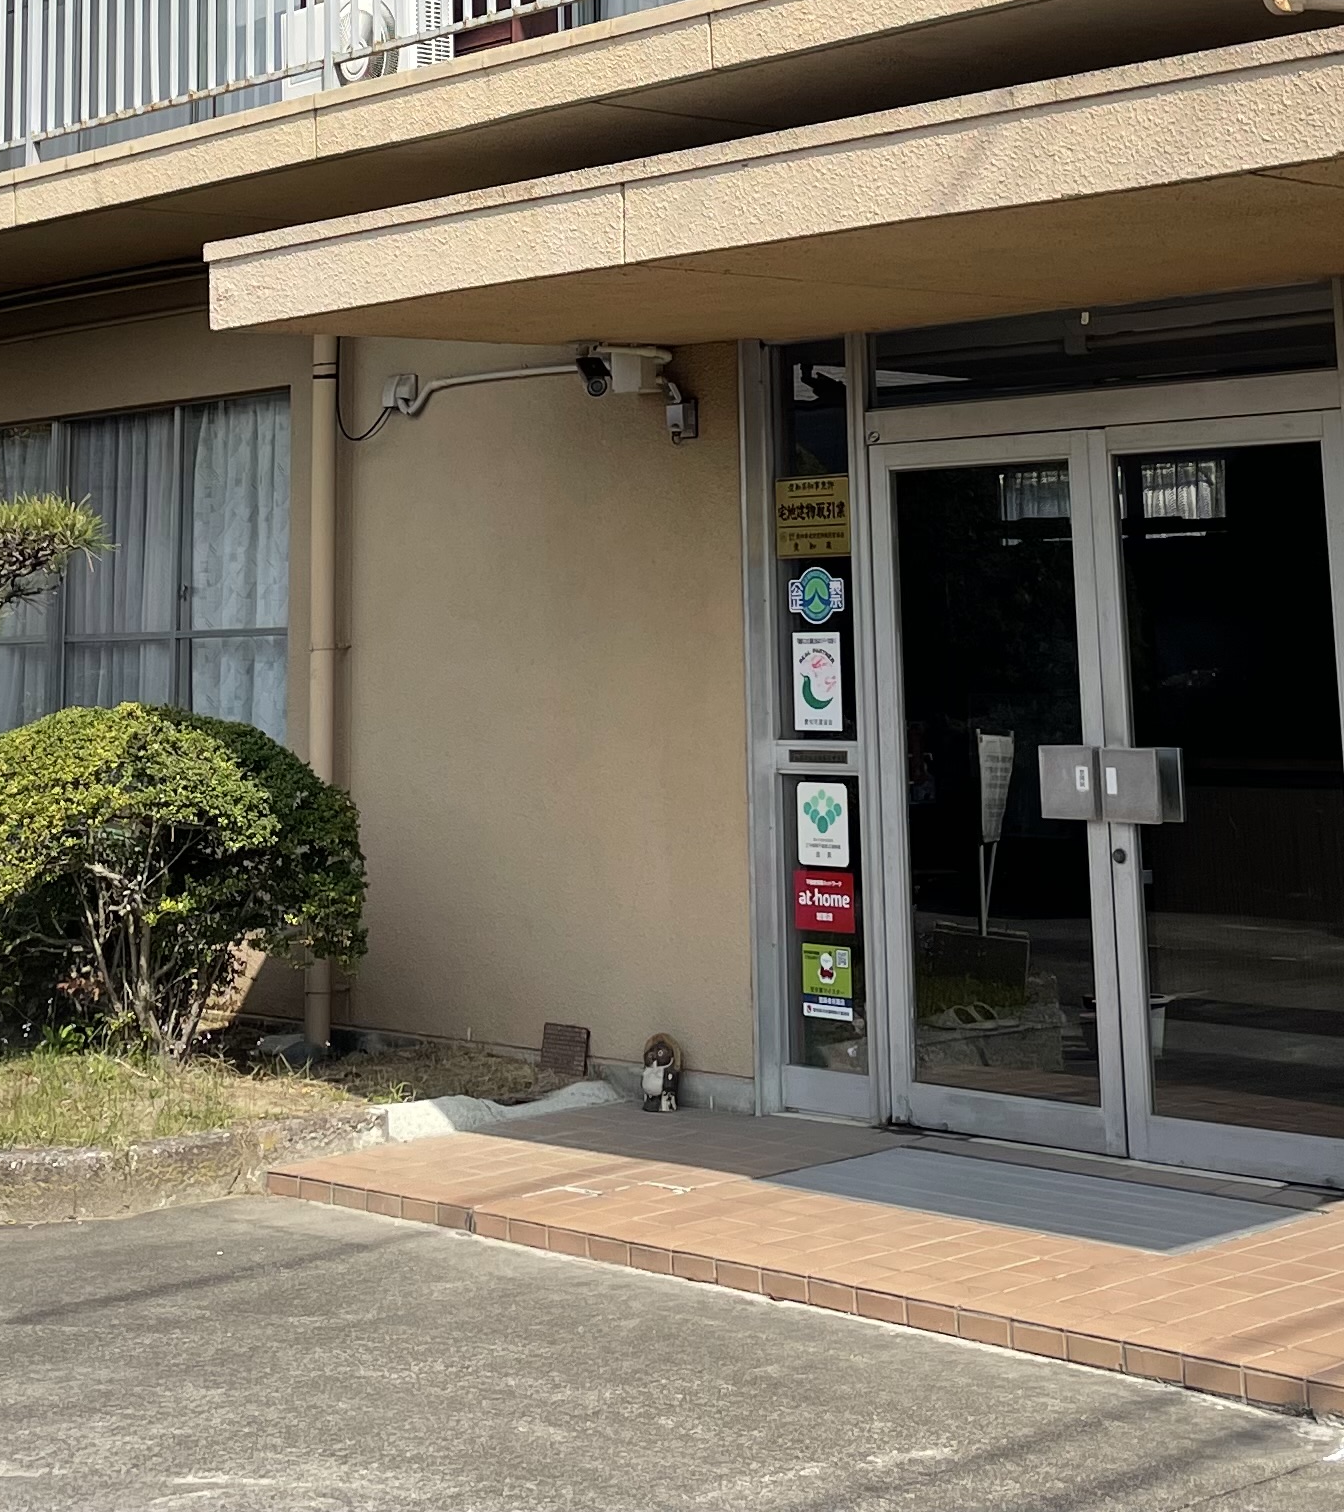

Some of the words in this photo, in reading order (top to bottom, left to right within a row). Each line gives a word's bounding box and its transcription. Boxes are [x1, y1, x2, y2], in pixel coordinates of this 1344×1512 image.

[778, 500, 846, 521] 宅地建物取引業
[798, 890, 812, 905] at
[813, 888, 850, 908] home
